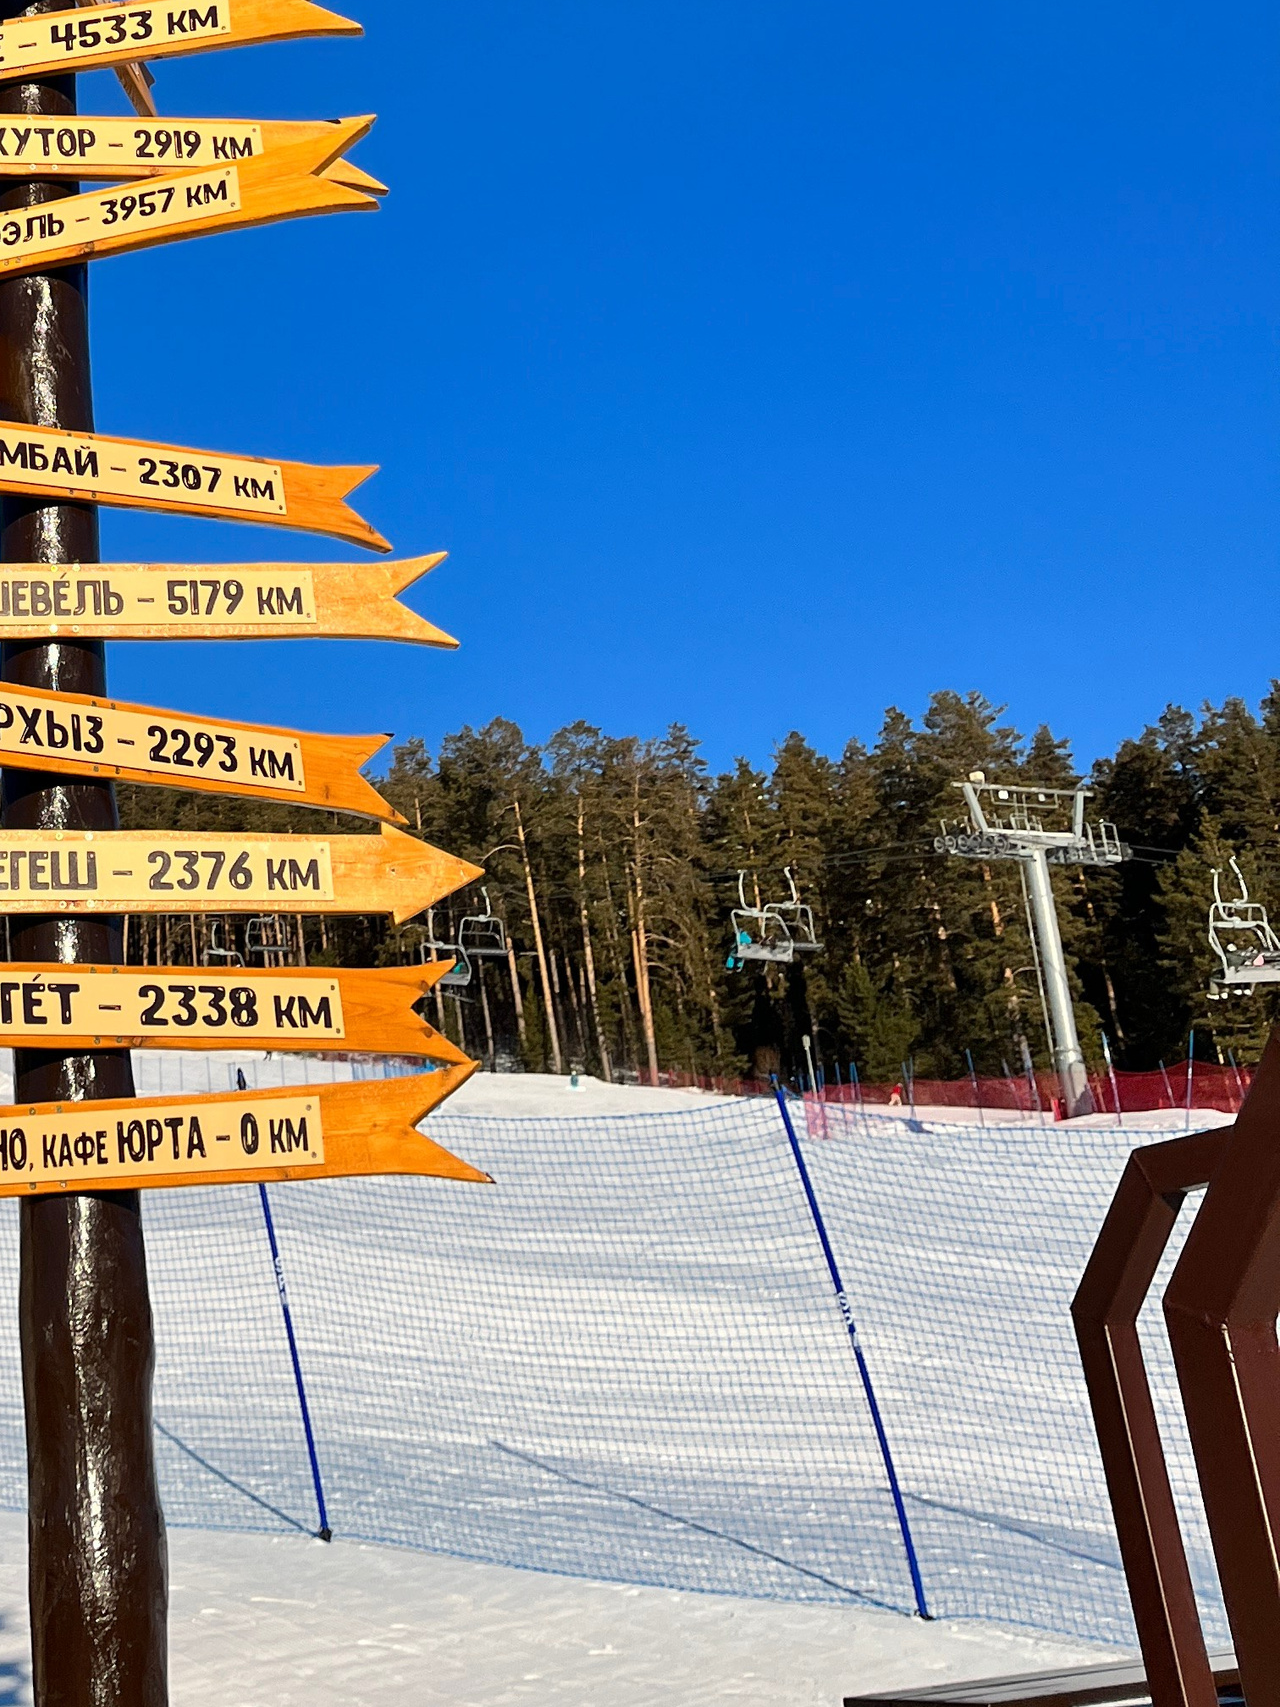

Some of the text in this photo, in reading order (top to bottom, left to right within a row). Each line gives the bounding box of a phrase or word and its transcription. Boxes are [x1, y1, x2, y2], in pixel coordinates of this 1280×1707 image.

[50, 9, 153, 51] 4533
[168, 6, 218, 35] КМ
[134, 130, 201, 158] 2919
[213, 137, 252, 159] КМ
[99, 184, 175, 224] 3957
[186, 180, 227, 207] КМ
[137, 457, 222, 494] 2307
[234, 476, 274, 500] КМ
[167, 580, 243, 615] 5179
[257, 587, 303, 615] КМ
[147, 725, 238, 773] 2293
[249, 747, 294, 781] КМ
[148, 851, 252, 890] 2376
[267, 859, 320, 890] КМ
[139, 985, 258, 1027] 2338
[274, 995, 332, 1028] КМ
[43, 1131, 108, 1168] КАФЕ
[117, 1116, 206, 1163] ЮРТА
[269, 1117, 308, 1153] КМ
